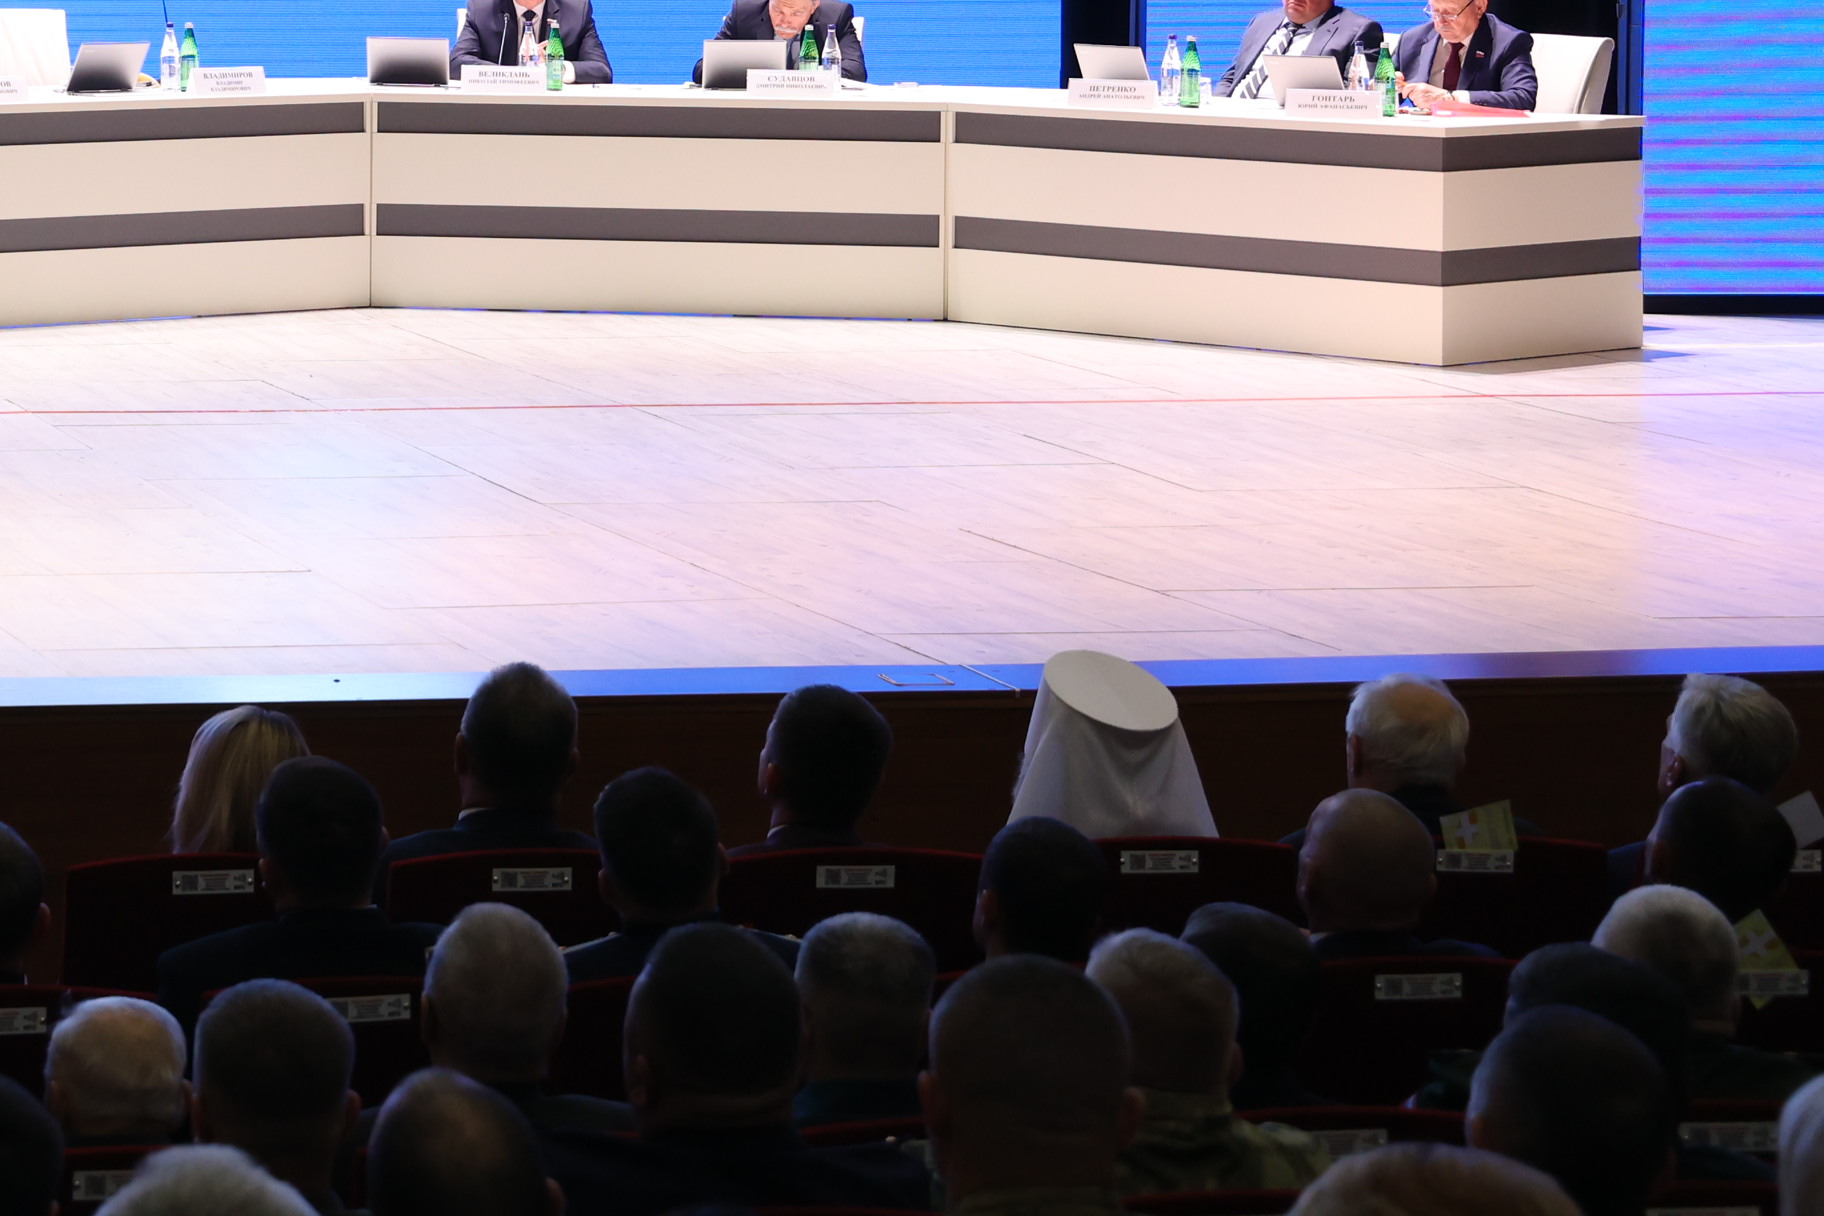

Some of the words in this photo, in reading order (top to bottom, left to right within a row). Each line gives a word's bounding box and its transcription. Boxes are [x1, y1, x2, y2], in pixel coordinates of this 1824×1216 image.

[767, 75, 815, 83] СУДАВЦОВ
[1089, 85, 1137, 93] ПЕТРЕНКО
[1311, 95, 1355, 103] ГОНТАРЬ
